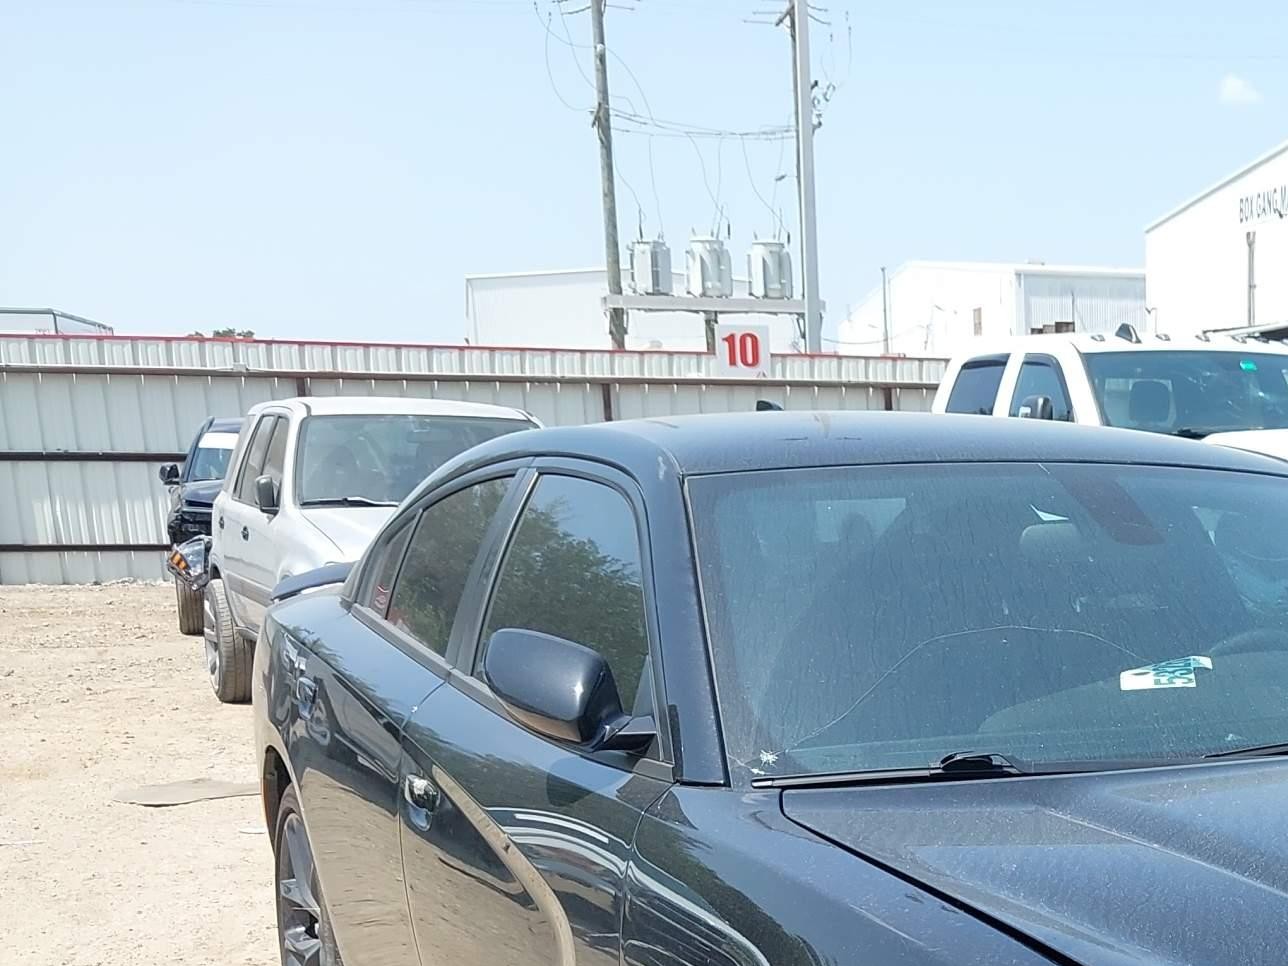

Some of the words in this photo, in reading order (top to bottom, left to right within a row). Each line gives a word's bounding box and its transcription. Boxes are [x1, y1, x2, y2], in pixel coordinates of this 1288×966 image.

[1238, 197, 1254, 224] BOX
[1256, 187, 1278, 219] GANG
[721, 332, 760, 368] 10
